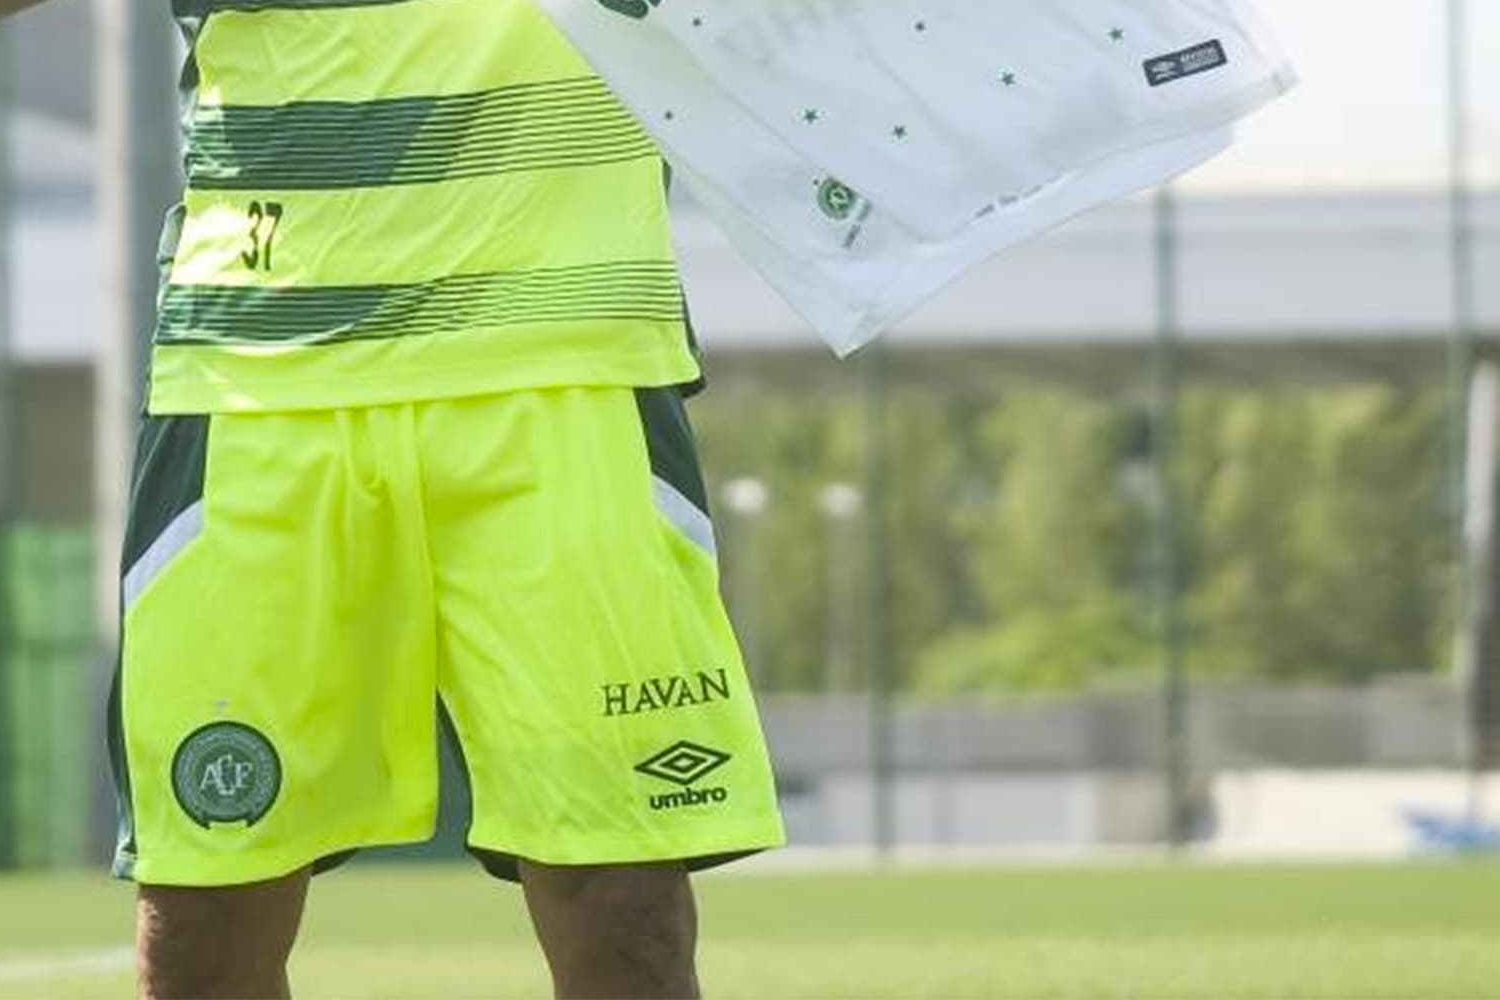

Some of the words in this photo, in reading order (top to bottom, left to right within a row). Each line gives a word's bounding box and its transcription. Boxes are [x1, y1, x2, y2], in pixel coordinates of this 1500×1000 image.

[241, 199, 284, 272] 37
[601, 668, 730, 717] HAVAN
[649, 786, 727, 811] umbro
